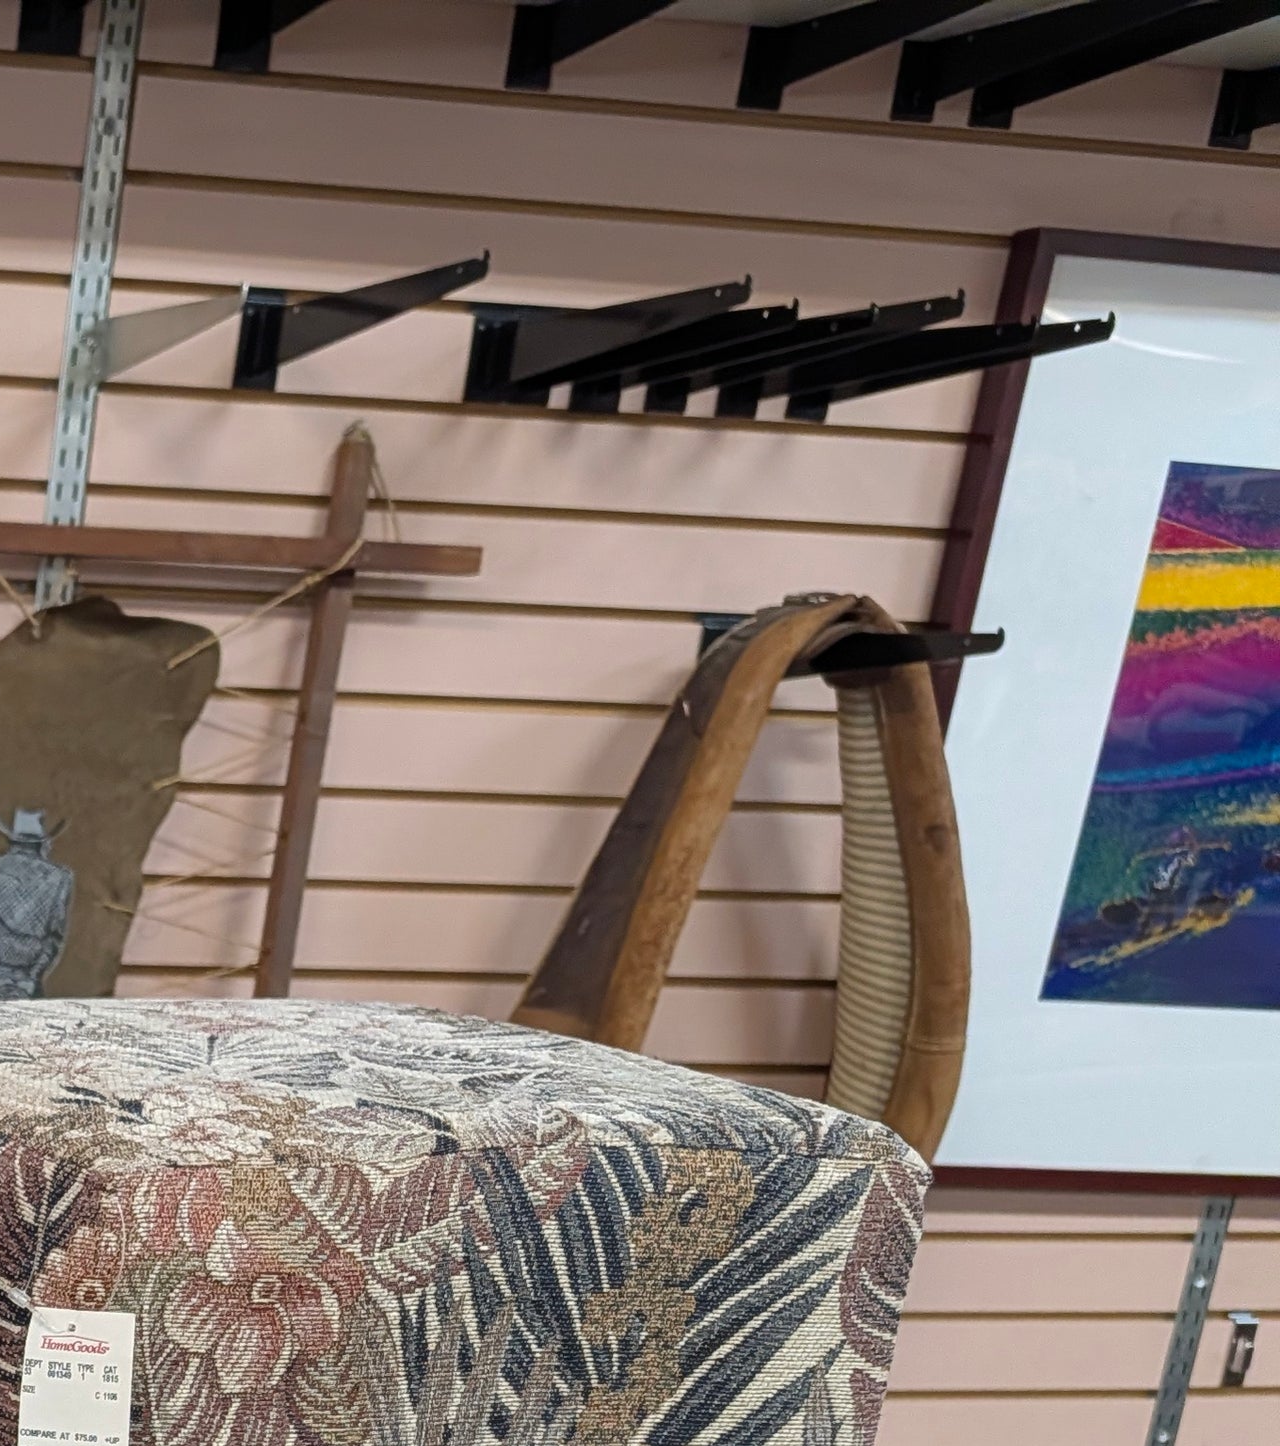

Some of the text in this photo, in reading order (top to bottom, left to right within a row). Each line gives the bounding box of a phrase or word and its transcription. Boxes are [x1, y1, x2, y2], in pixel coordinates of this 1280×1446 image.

[41, 1338, 109, 1354] HomeGoods
[24, 1358, 118, 1375] DEPT STYLE TYPE CAT
[102, 1375, 119, 1383] 1815
[22, 1385, 36, 1394] SIZE
[20, 1428, 57, 1440] COMPARE
[59, 1432, 70, 1440] AT
